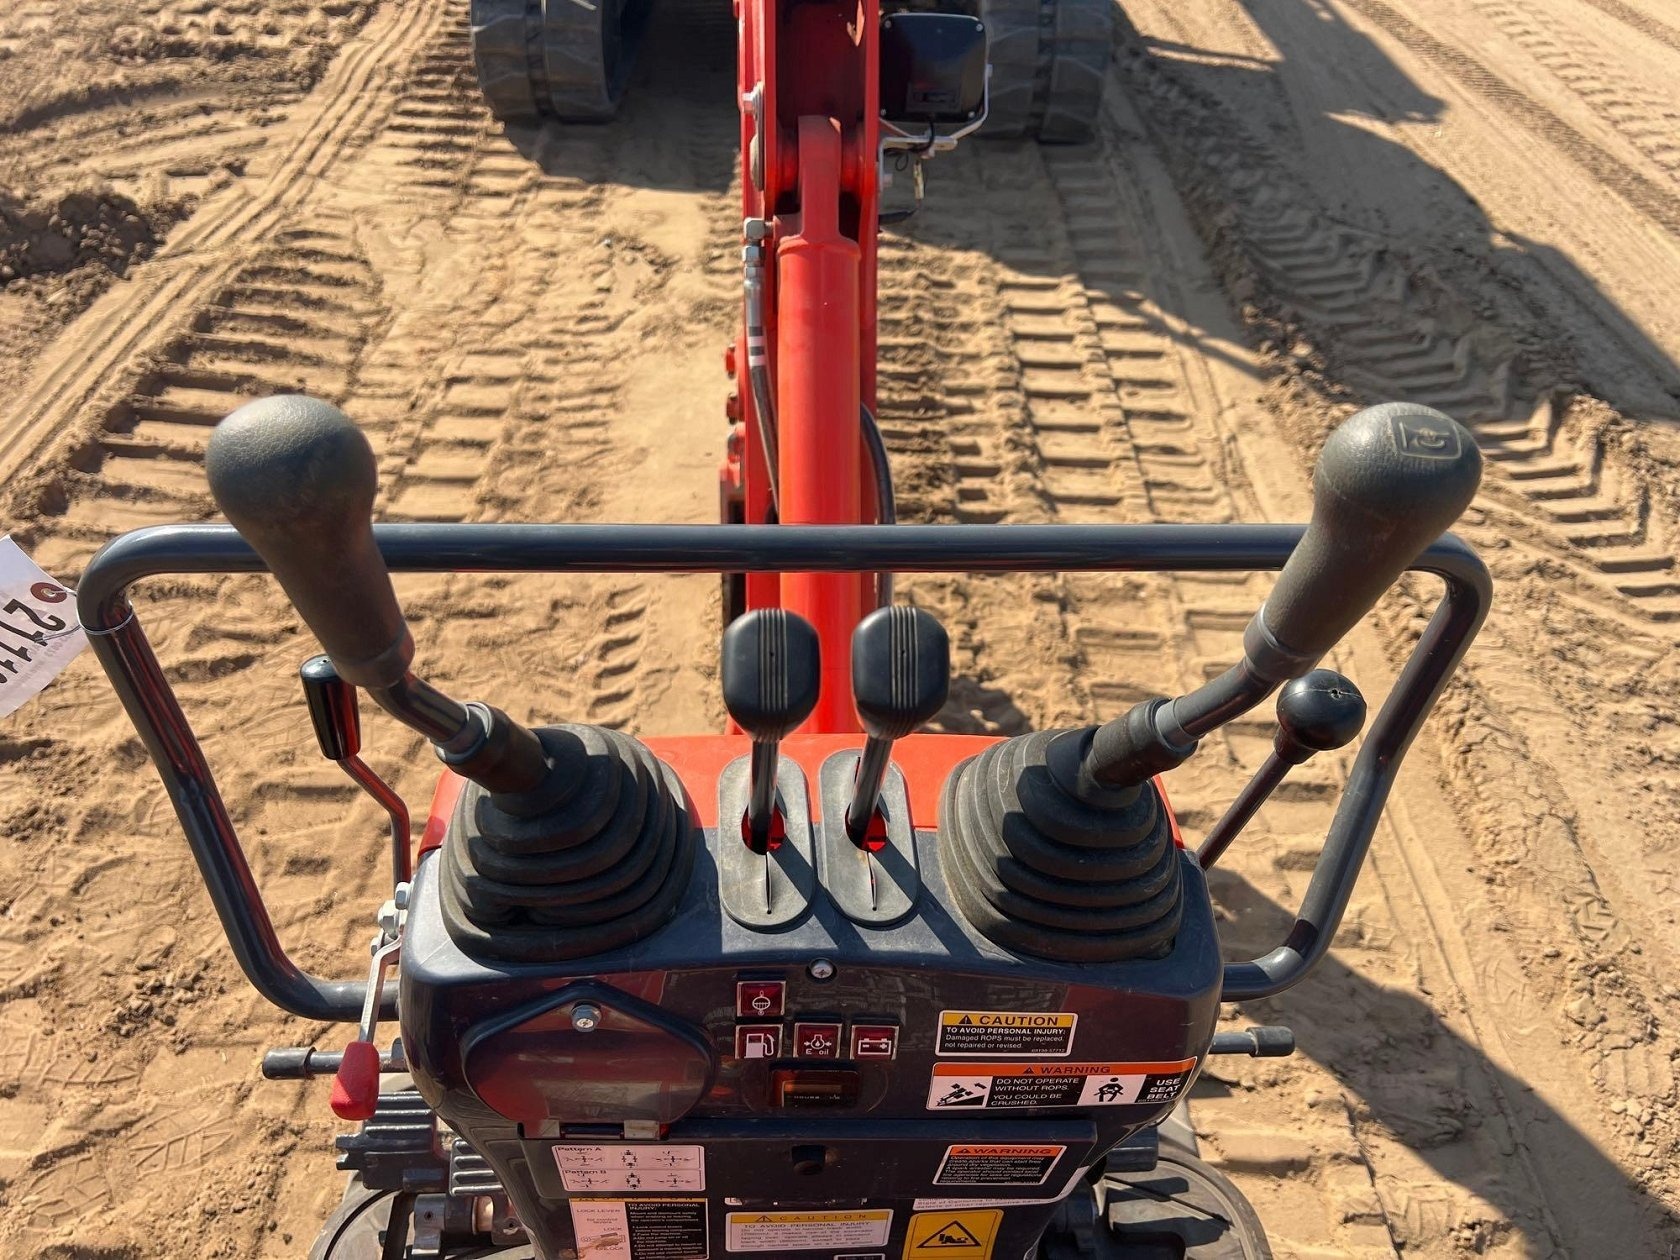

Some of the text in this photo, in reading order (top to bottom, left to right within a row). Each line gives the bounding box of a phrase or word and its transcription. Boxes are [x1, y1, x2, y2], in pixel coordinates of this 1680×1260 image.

[0, 598, 67, 684] 211
[979, 1015, 1059, 1026] CAUTION
[946, 1026, 957, 1034] TO
[987, 1027, 1031, 1035] PERSONAL
[945, 1034, 979, 1042] Damaged
[1040, 1066, 1111, 1074] WARNING
[1156, 1077, 1181, 1086] USE
[1149, 1084, 1181, 1093] SEAT
[1146, 1091, 1178, 1100] BELT
